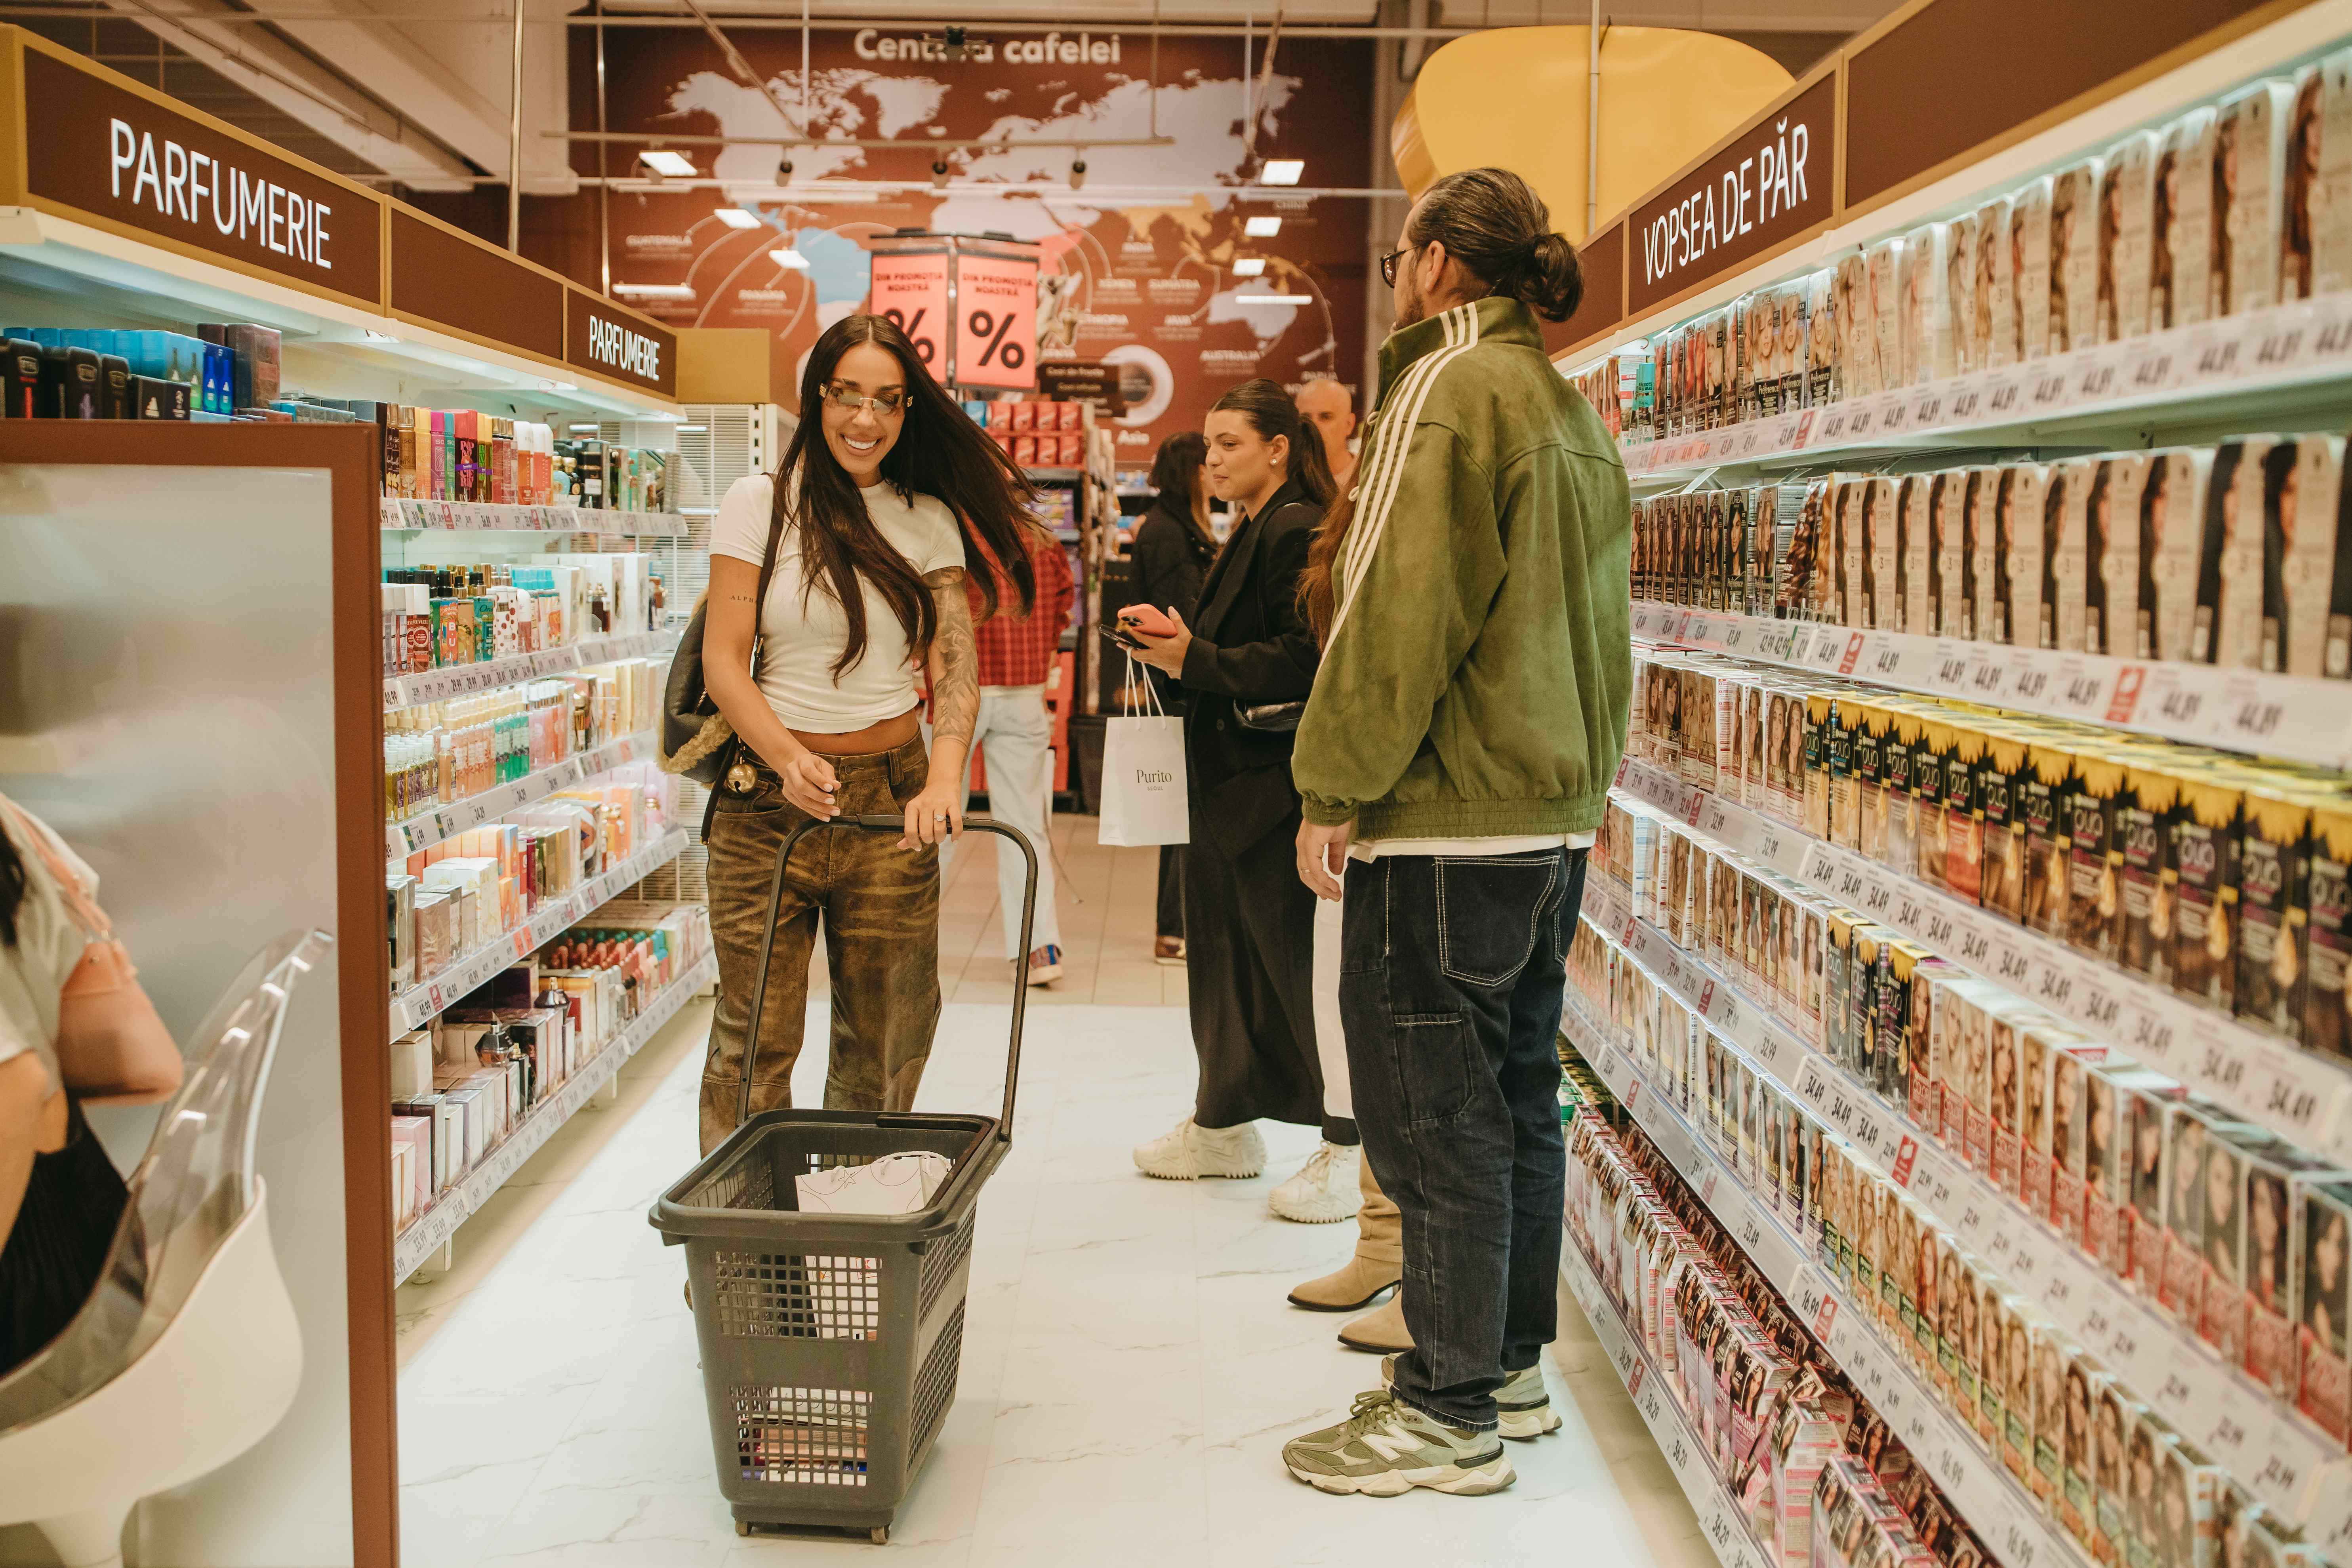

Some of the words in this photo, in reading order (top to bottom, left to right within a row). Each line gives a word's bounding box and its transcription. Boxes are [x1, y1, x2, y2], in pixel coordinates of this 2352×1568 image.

[854, 29, 994, 63] Centa
[1003, 31, 1121, 64] cafelei
[111, 118, 332, 270] PARFUMERIE
[1644, 184, 1716, 285] VOPSEA
[1723, 157, 1753, 244] DE
[1759, 116, 1808, 225] PĂR
[1121, 242, 1155, 253] INDIA
[875, 272, 891, 281] DIN
[963, 273, 979, 282] DIN
[589, 315, 661, 381] PARFUMERIE
[969, 310, 1025, 369] %
[1199, 349, 1260, 361] AUSTRALIA
[1116, 429, 1149, 446] Asia
[730, 595, 757, 603] ALPH
[385, 690, 398, 705] 40,99
[1136, 769, 1172, 783] Purito
[1814, 859, 1834, 886] 34,49
[1841, 872, 1862, 899] 34,49
[1867, 885, 1890, 913] 34,49
[1927, 915, 1952, 942] 34,49
[446, 983, 458, 1000] 40,99
[419, 1000, 431, 1018] 40,99
[1760, 1036, 1777, 1061] 32,99
[1805, 1075, 1825, 1104] 34,49
[1832, 1096, 1852, 1126] 34,49
[1857, 1116, 1879, 1148] 34,49
[413, 1229, 427, 1254] 33,99
[432, 1217, 446, 1240] 33,99
[1743, 1221, 1759, 1249] 33,49
[1801, 1289, 1820, 1320] 16,99
[1619, 1345, 1632, 1374] 36,29
[1781, 1345, 1792, 1356] 4102
[1646, 1393, 1659, 1422] 36,29
[1733, 1408, 1756, 1437] casting
[1673, 1438, 1688, 1471] 36,29
[1712, 1513, 1730, 1548] 36,29
